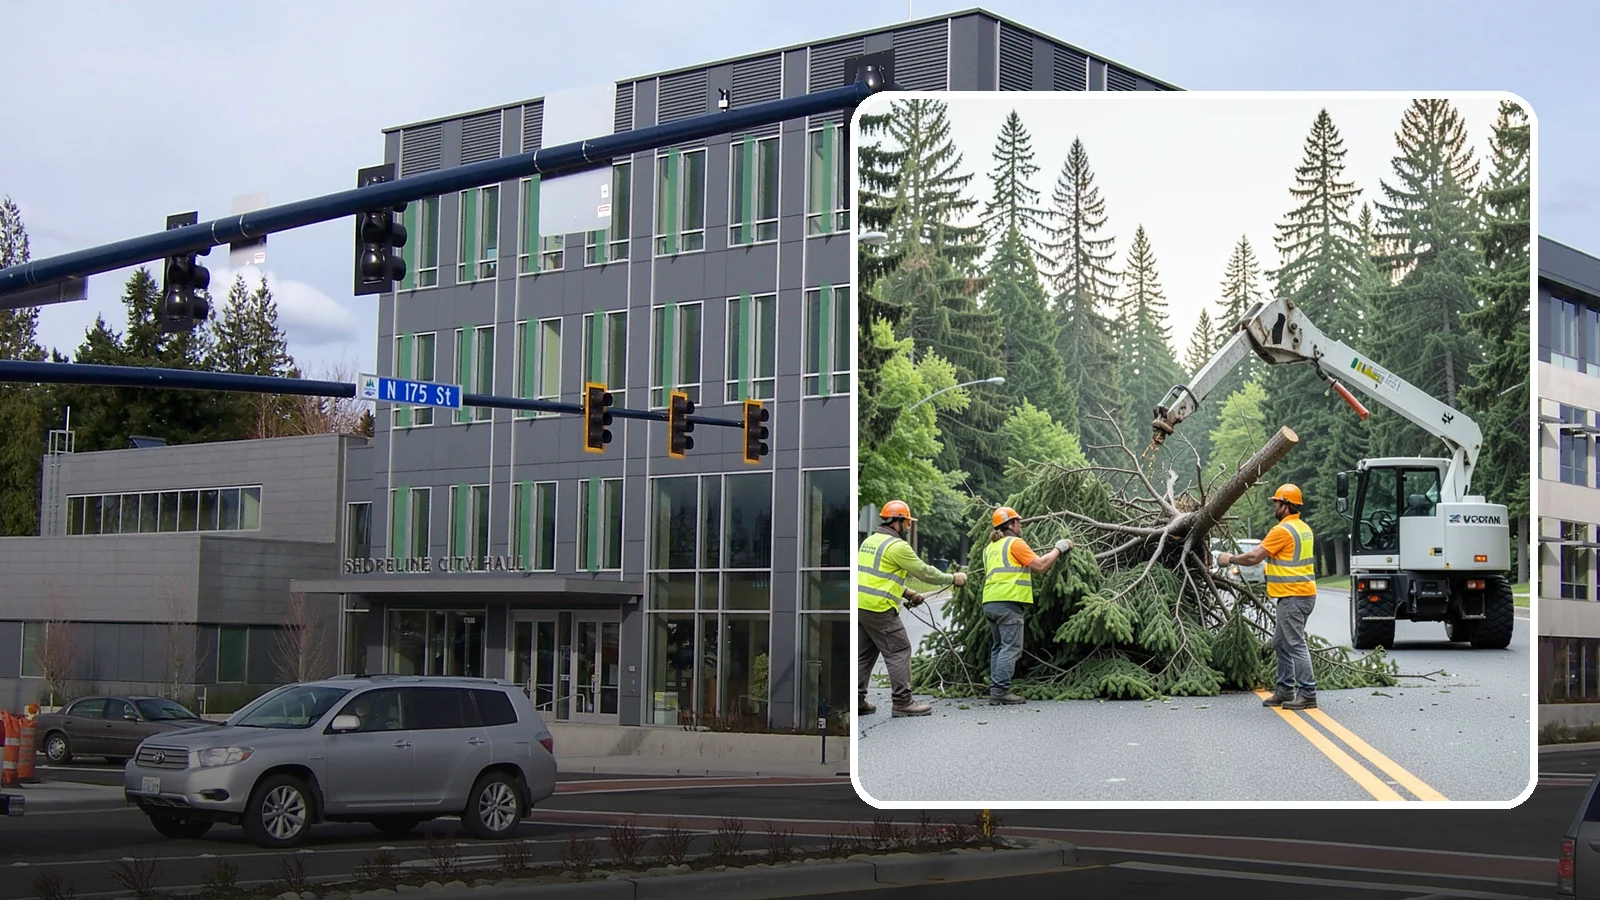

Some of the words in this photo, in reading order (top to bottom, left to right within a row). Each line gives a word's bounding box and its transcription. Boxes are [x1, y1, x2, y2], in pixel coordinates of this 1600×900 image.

[387, 380, 396, 400] N
[405, 382, 427, 403] 175
[436, 386, 451, 406] St
[344, 556, 432, 574] SHORELINE
[438, 555, 476, 572] CITY
[483, 555, 526, 572] HALL
